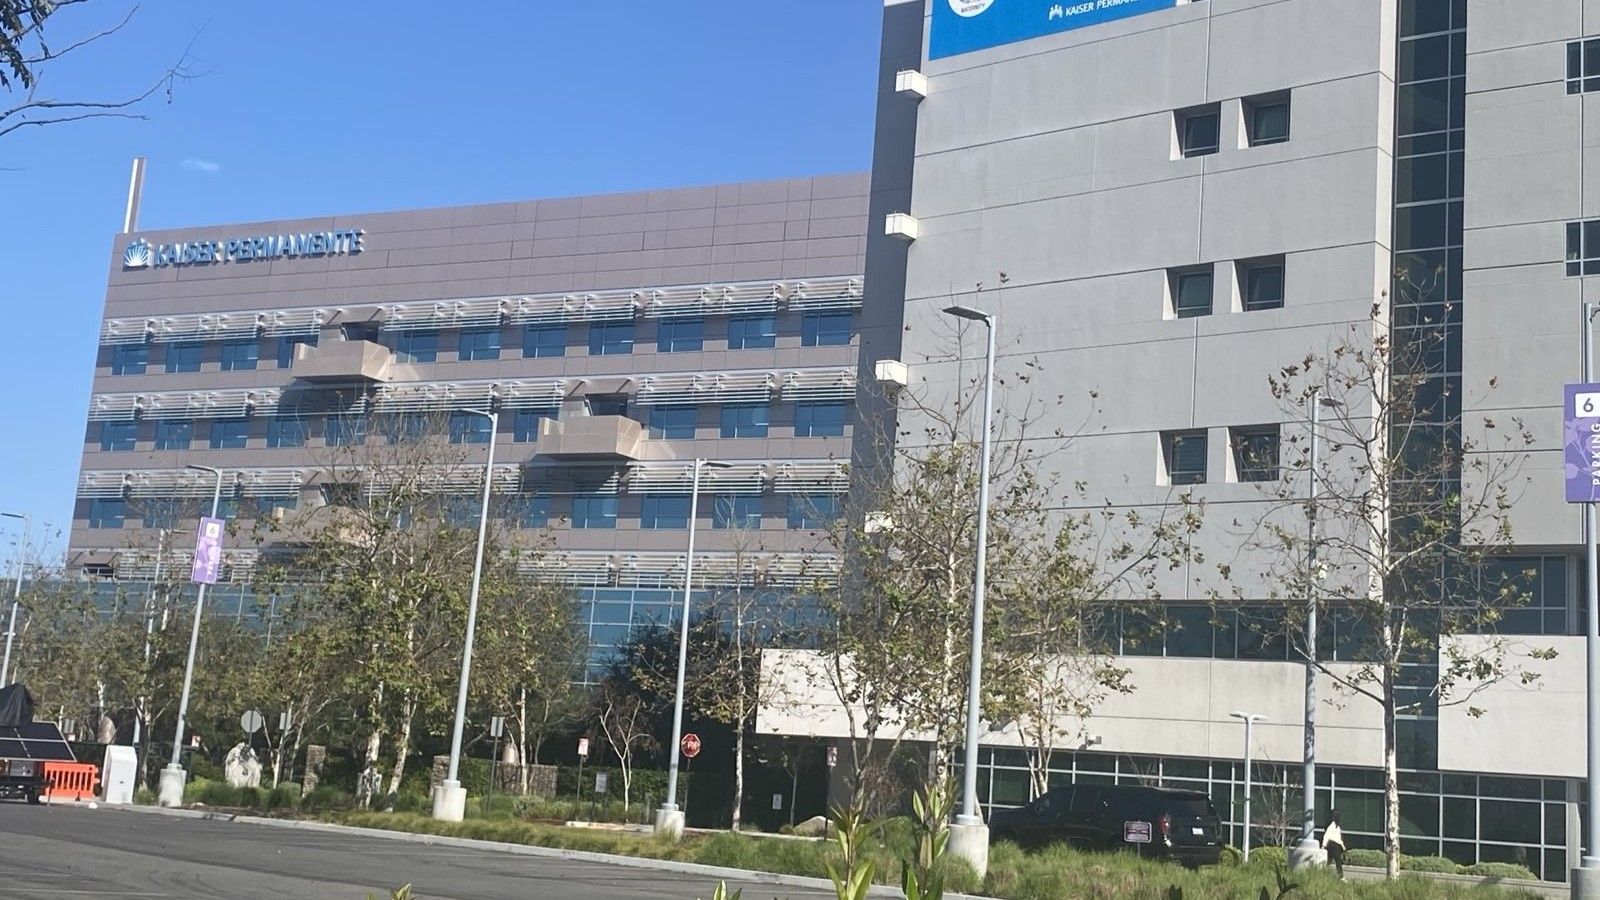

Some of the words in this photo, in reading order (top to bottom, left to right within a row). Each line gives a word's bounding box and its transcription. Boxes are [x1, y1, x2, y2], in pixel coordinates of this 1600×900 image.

[1065, 2, 1094, 17] KAISER
[154, 241, 222, 265] KAISER
[224, 229, 365, 261] PERMANENTE
[1583, 397, 1594, 413] 6
